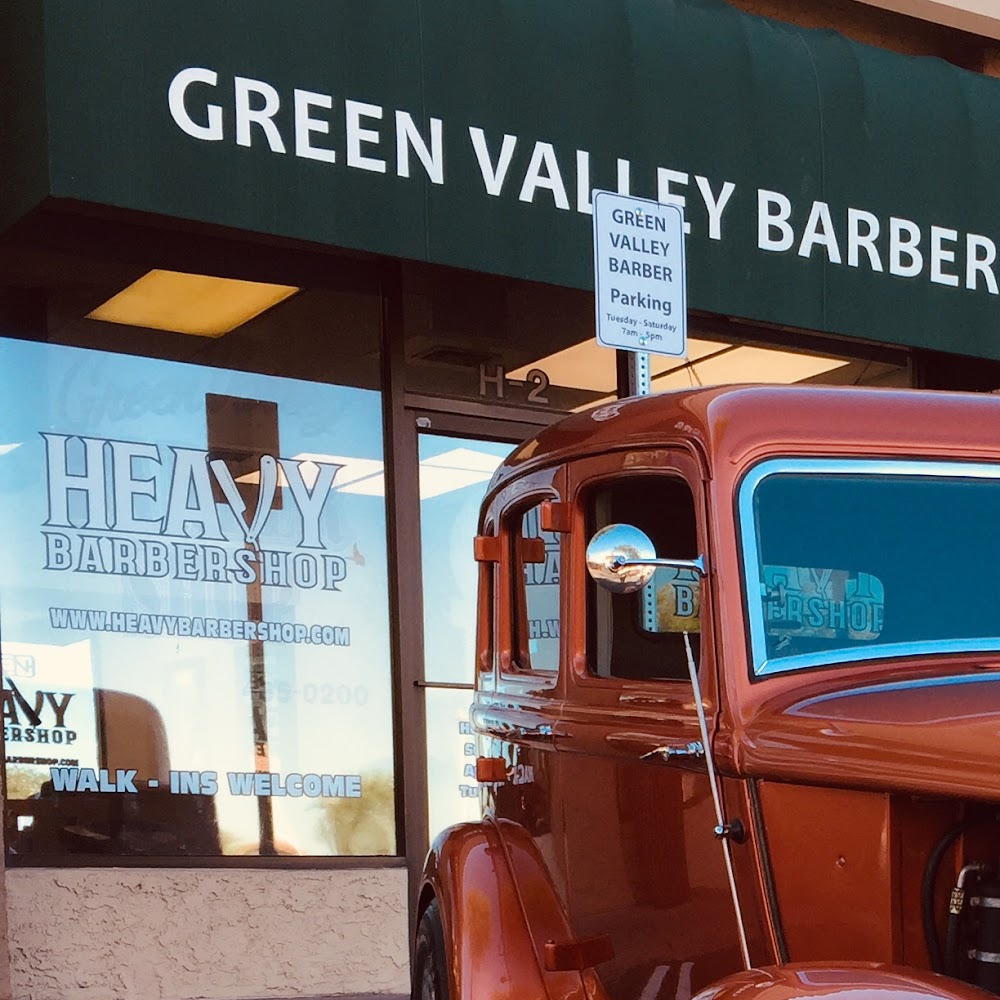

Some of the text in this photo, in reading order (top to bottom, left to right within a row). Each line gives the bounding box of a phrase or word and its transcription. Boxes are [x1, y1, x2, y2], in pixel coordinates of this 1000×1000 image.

[168, 68, 444, 184] GREEN
[757, 188, 1000, 296] BARBER
[612, 208, 666, 233] GREEN
[609, 232, 670, 257] VALLEY
[608, 257, 673, 283] BARBER
[610, 288, 672, 316] Parking
[606, 313, 638, 327] Tuesday
[643, 319, 677, 333] Saturday
[621, 328, 639, 337] 7am
[38, 431, 347, 551] HEAVY
[40, 530, 347, 592] BARBERSHOP
[48, 607, 351, 647] WWW.HEAVYBARBERSHOP.COM
[49, 767, 139, 794] WALK
[169, 771, 219, 796] INS
[227, 772, 362, 798] WELCOME
